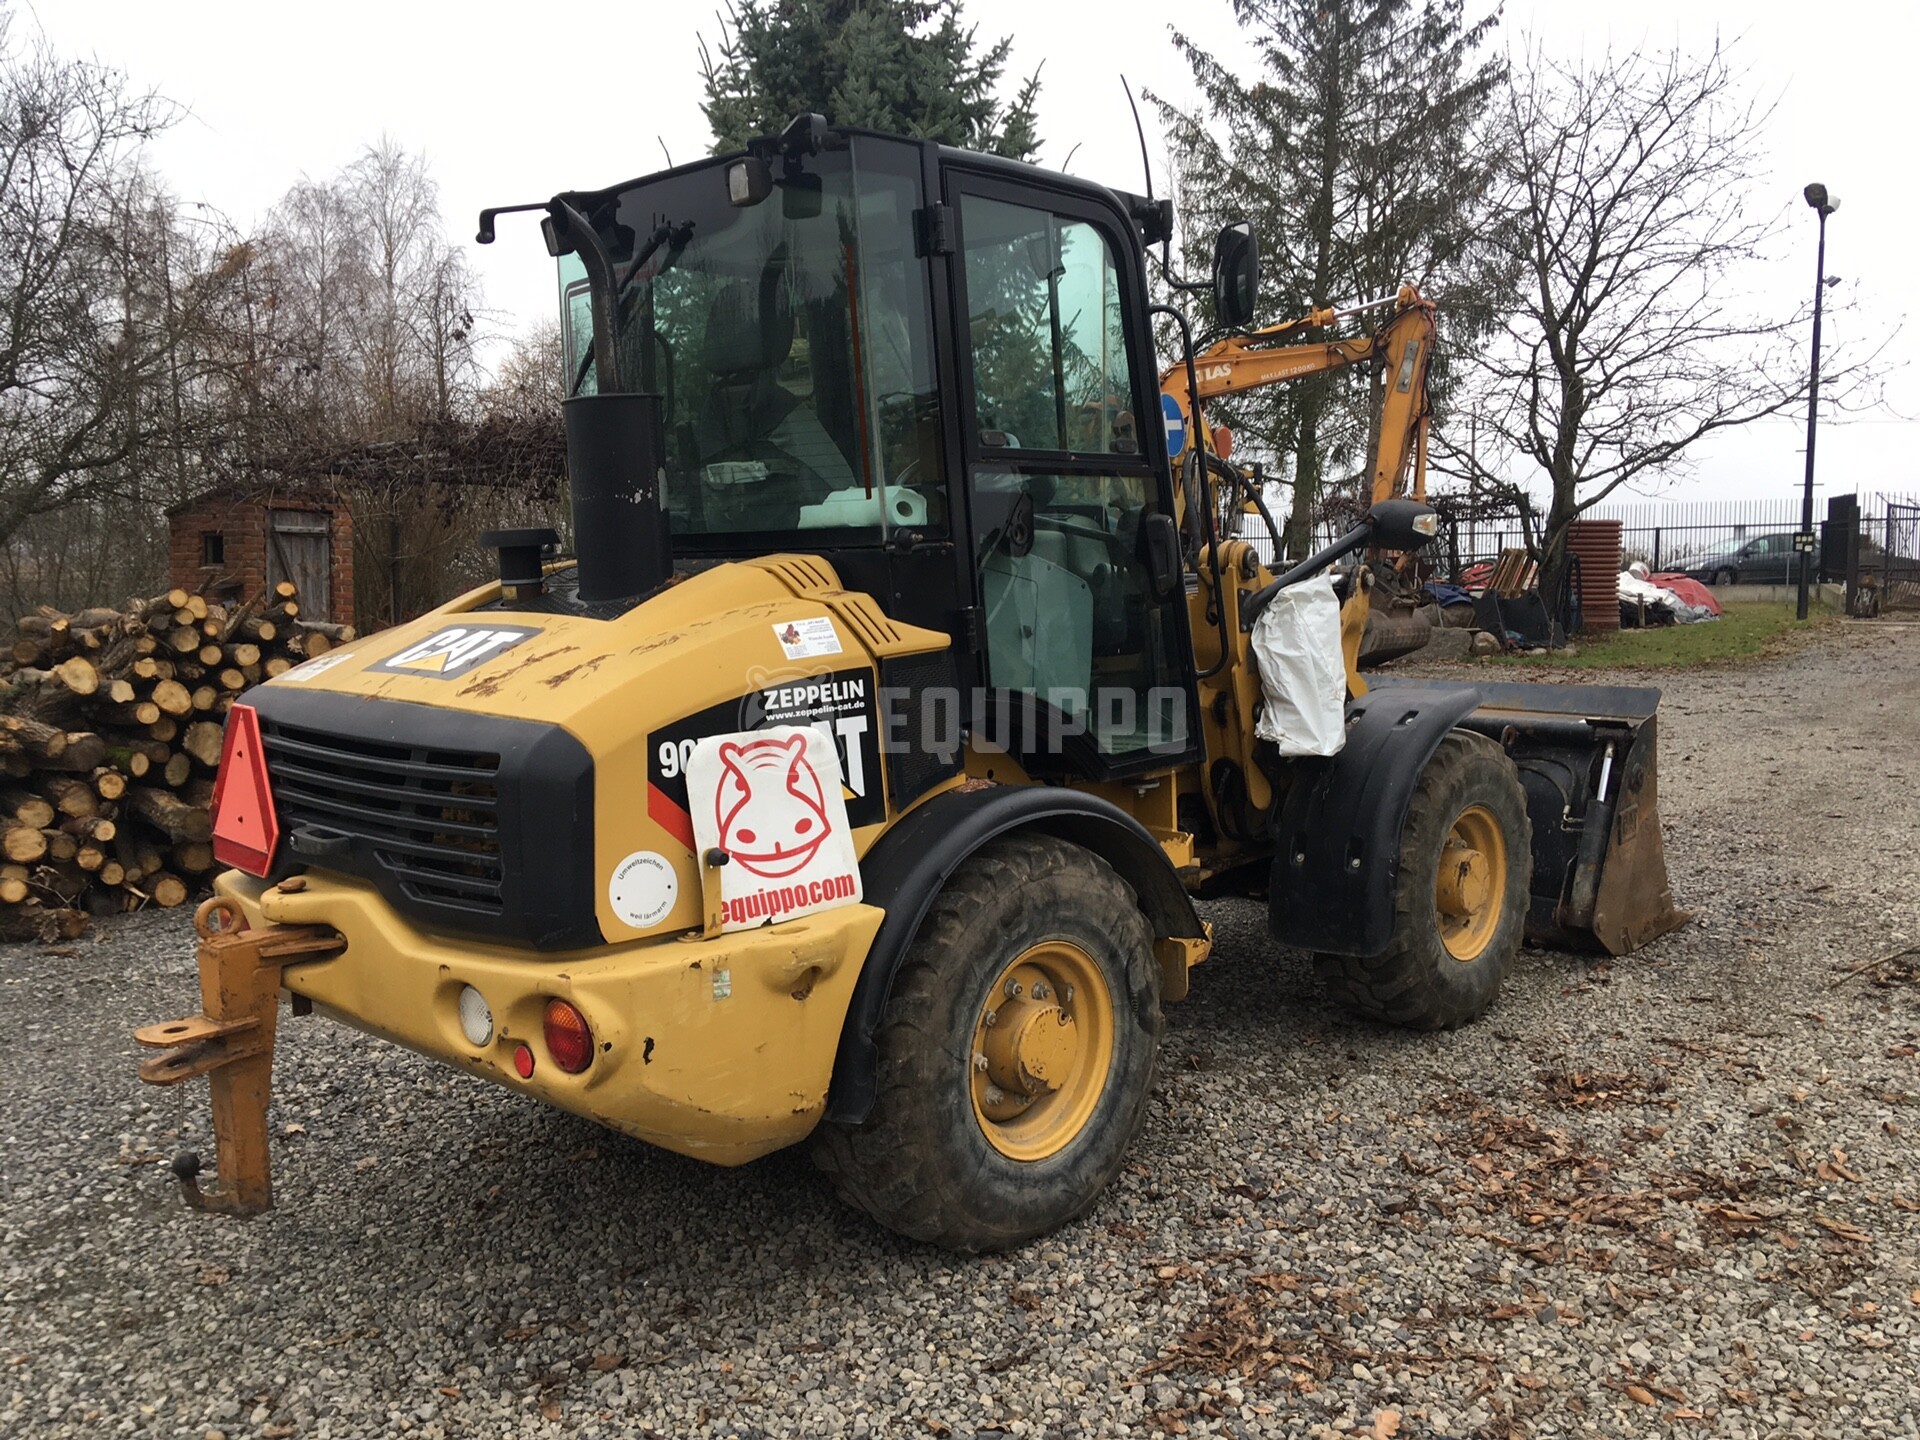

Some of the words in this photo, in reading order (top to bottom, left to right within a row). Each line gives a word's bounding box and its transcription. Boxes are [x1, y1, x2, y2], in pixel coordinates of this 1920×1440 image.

[385, 628, 524, 673] CAT
[763, 679, 865, 710] ZEPPELIN
[766, 700, 866, 722] www.zeppelin-cat.de
[618, 857, 664, 880] Umweltzeichen
[721, 873, 856, 924] equippo.com
